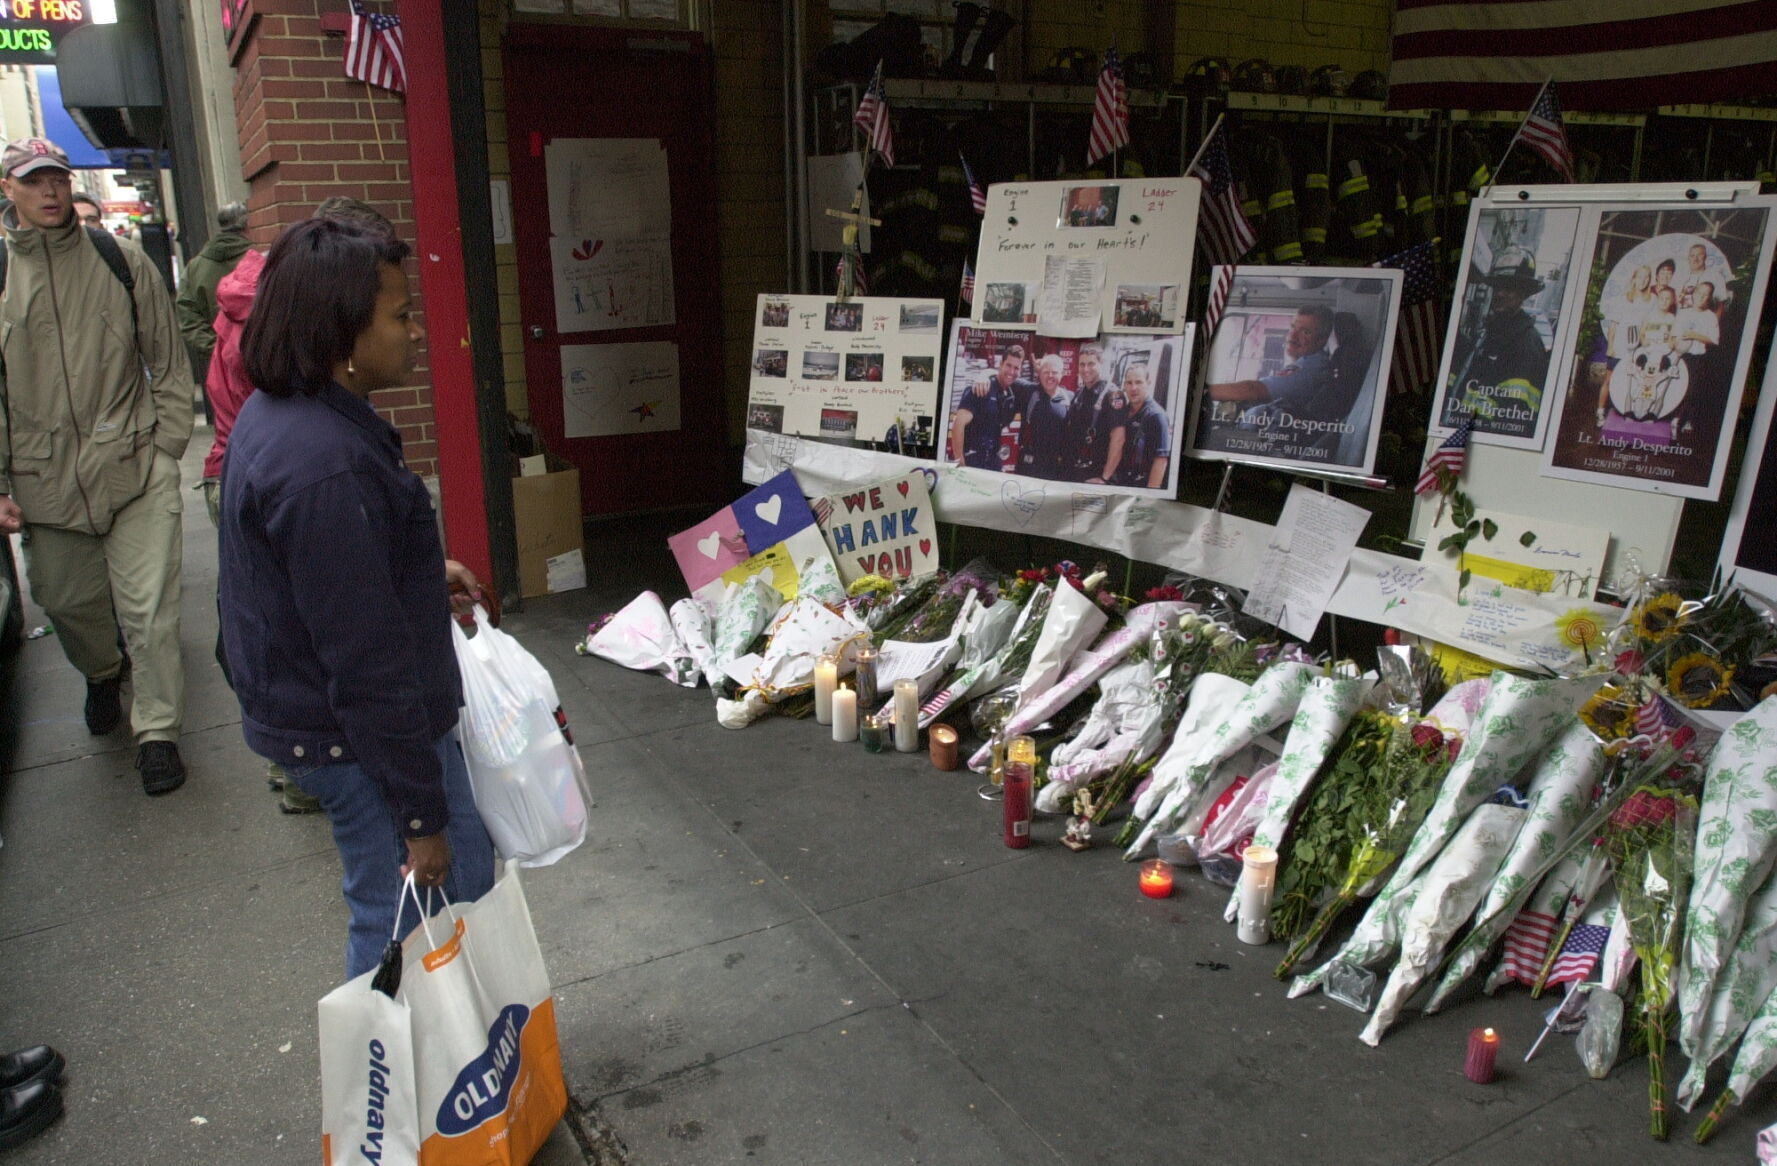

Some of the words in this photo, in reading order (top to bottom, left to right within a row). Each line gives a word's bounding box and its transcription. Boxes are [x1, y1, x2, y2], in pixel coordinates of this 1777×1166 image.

[12, 0, 35, 18] OF
[39, 0, 82, 20] PENS
[30, 140, 48, 156] B
[1003, 188, 1029, 199] Engine
[1009, 202, 1016, 211] 1
[1147, 201, 1164, 212] 24
[1043, 241, 1054, 250] in
[1068, 241, 1085, 250] our
[967, 329, 987, 338] Mike
[989, 330, 1029, 342] Weinberg
[1466, 379, 1521, 399] Captain
[1447, 397, 1475, 414] Dan
[1482, 400, 1535, 421] Brethel
[1211, 408, 1231, 422] Lt.
[1234, 410, 1275, 430] Andy
[1279, 413, 1355, 434] Desperito
[1258, 429, 1290, 442] Engine
[1578, 432, 1593, 444] Lt.
[1597, 434, 1630, 449] Andy
[1632, 437, 1693, 456] Desperito
[1225, 438, 1273, 452] 12/28/1957
[1283, 446, 1329, 459] 9/11/2001
[1613, 451, 1642, 463] Engine
[1635, 464, 1675, 478] 9/11/2001
[842, 487, 884, 514] WE
[857, 545, 912, 579] YOU
[360, 1038, 391, 1166] oldnavy
